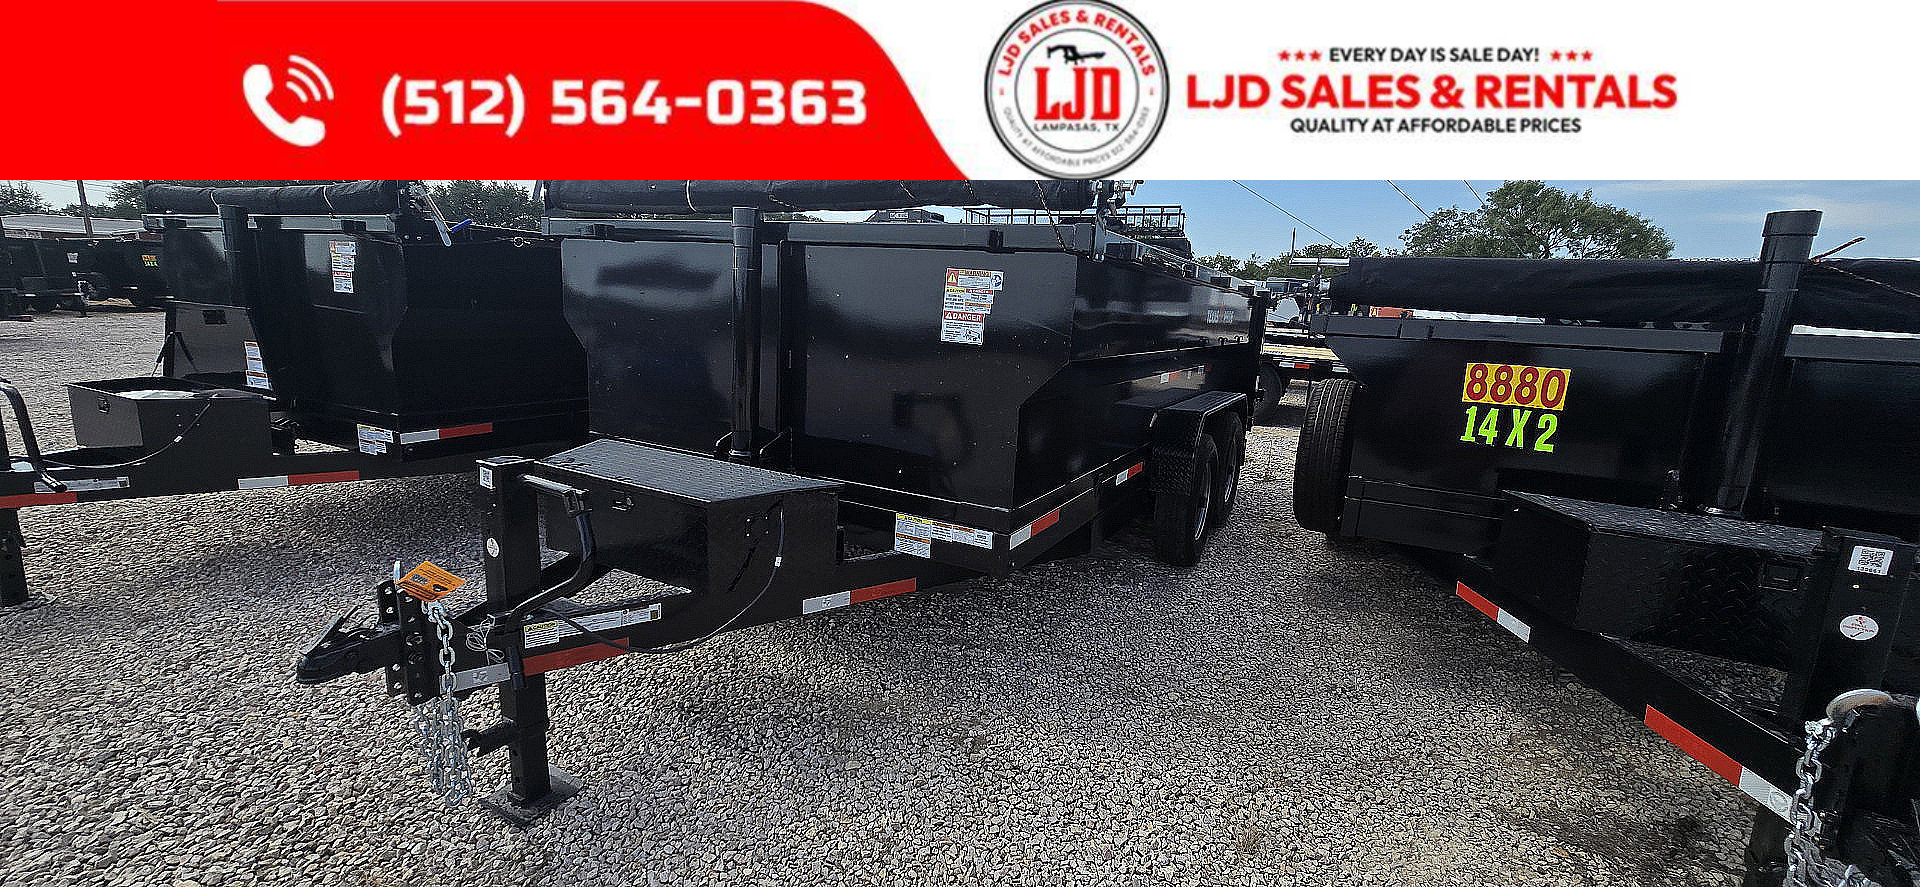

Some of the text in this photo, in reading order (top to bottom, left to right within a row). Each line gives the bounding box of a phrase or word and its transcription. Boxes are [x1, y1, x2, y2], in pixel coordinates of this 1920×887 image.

[953, 313, 982, 322] DANGER
[1466, 363, 1566, 408] 8880
[1460, 405, 1558, 453] 14 X 2
